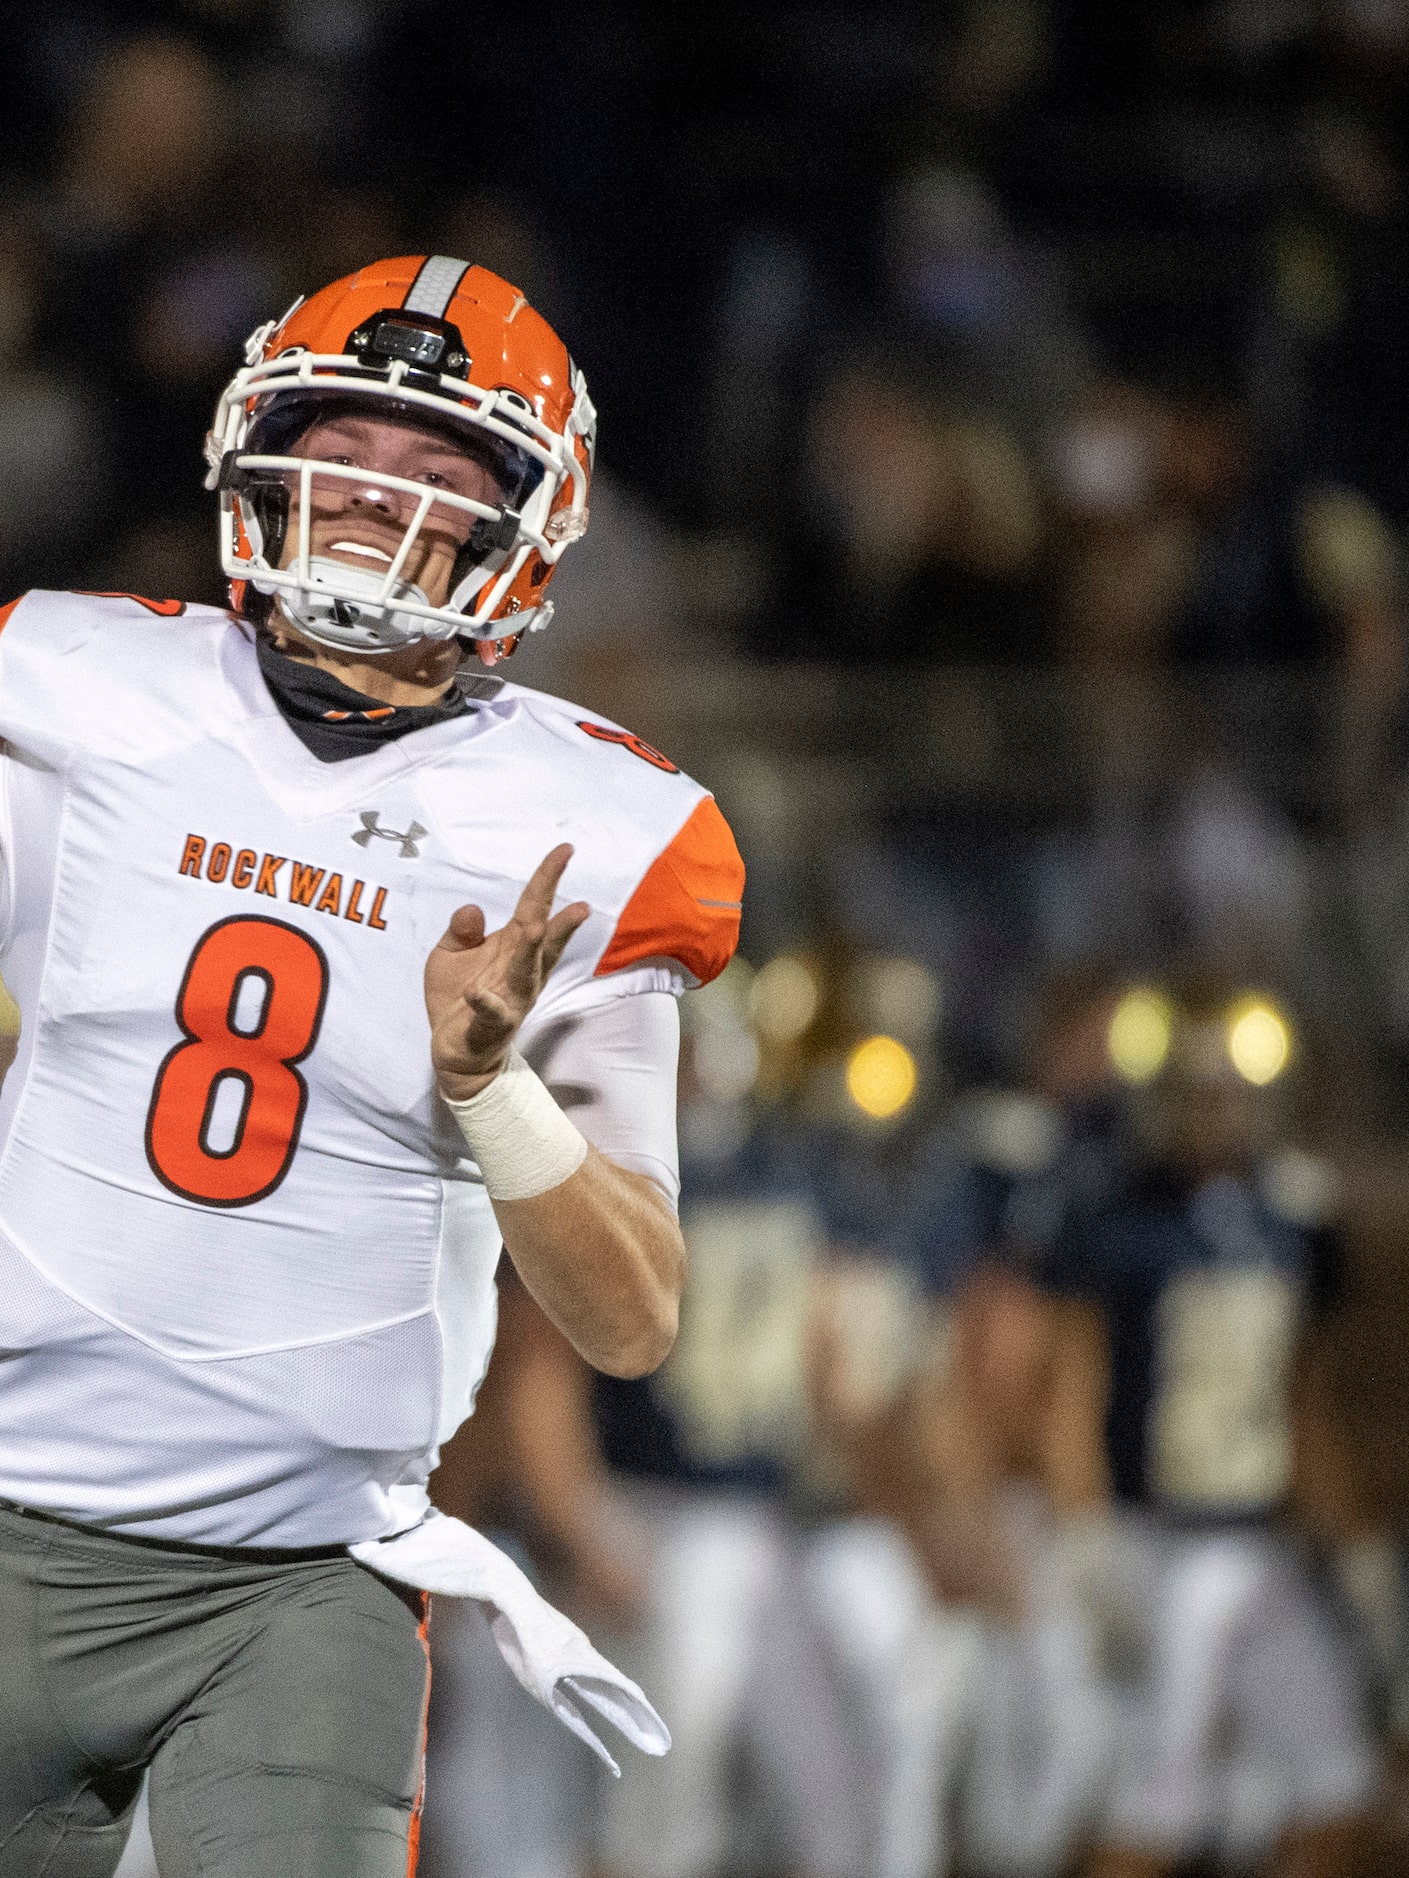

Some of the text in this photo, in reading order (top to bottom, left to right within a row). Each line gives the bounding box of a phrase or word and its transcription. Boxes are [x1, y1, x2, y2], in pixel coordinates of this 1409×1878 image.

[574, 721, 680, 774] 8
[178, 833, 388, 931] ROCKWALL
[144, 913, 330, 1209] 8
